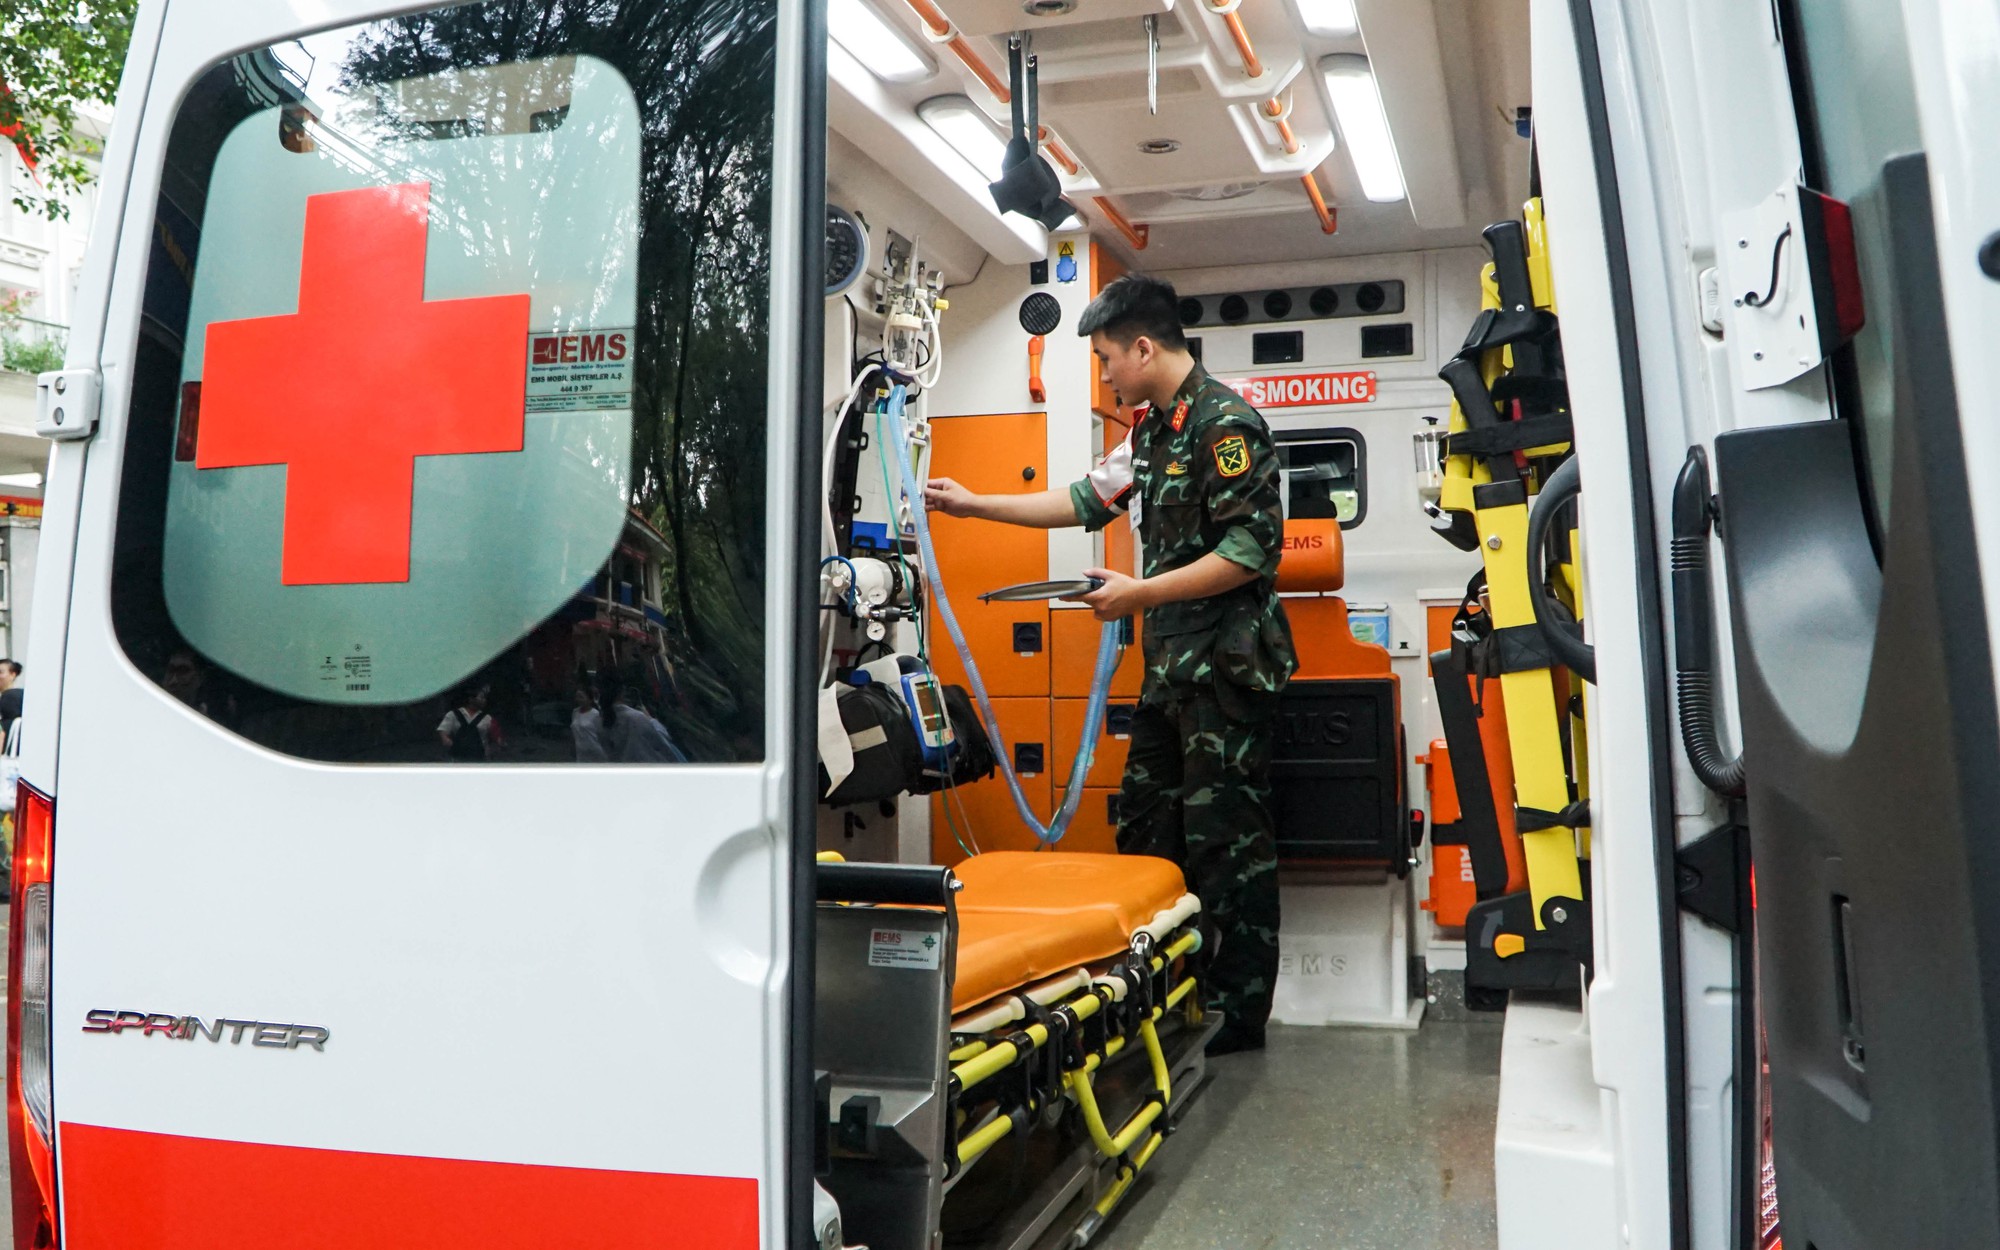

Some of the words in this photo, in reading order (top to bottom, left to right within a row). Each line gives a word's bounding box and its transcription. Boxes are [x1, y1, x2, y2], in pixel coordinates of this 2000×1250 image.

[560, 333, 626, 363] EMS
[1251, 376, 1367, 403] SMOKING
[1282, 535, 1323, 550] EMS
[882, 932, 902, 943] EMS
[1279, 954, 1347, 976] EMS
[82, 1008, 331, 1051] SPRINTER
